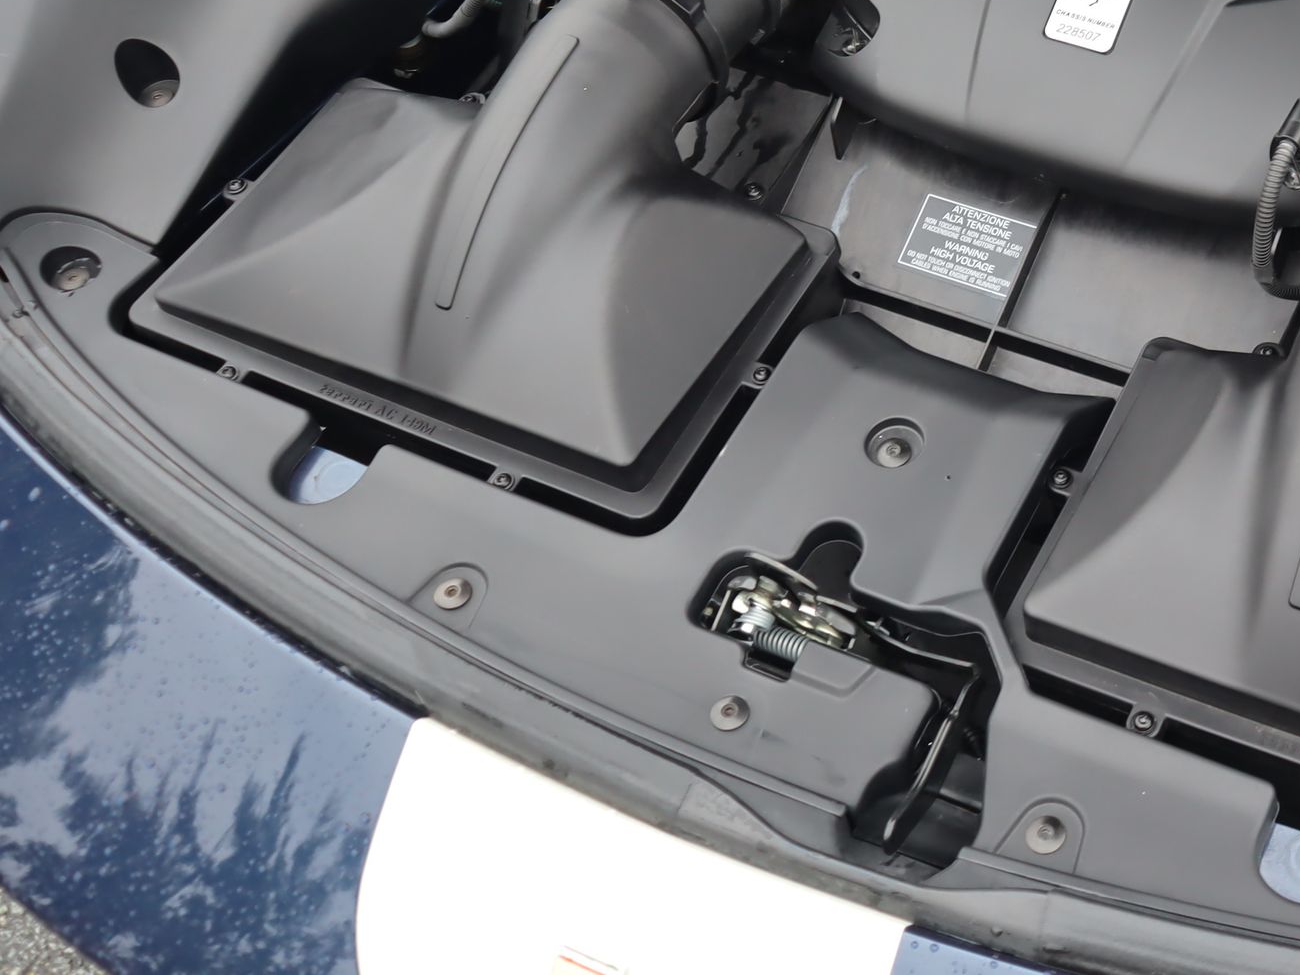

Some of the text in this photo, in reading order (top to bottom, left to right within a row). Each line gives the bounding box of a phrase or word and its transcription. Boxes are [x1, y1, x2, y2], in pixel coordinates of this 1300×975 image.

[1056, 9, 1116, 30] CHASSIS NUMBER
[1055, 23, 1102, 42] 228507
[942, 212, 1012, 240] ALTA TENSIONE
[952, 205, 1011, 229] ATTENZIONE
[929, 246, 996, 274] HIGH VOLTAGE
[944, 240, 989, 261] WARNING
[374, 407, 398, 420] AC
